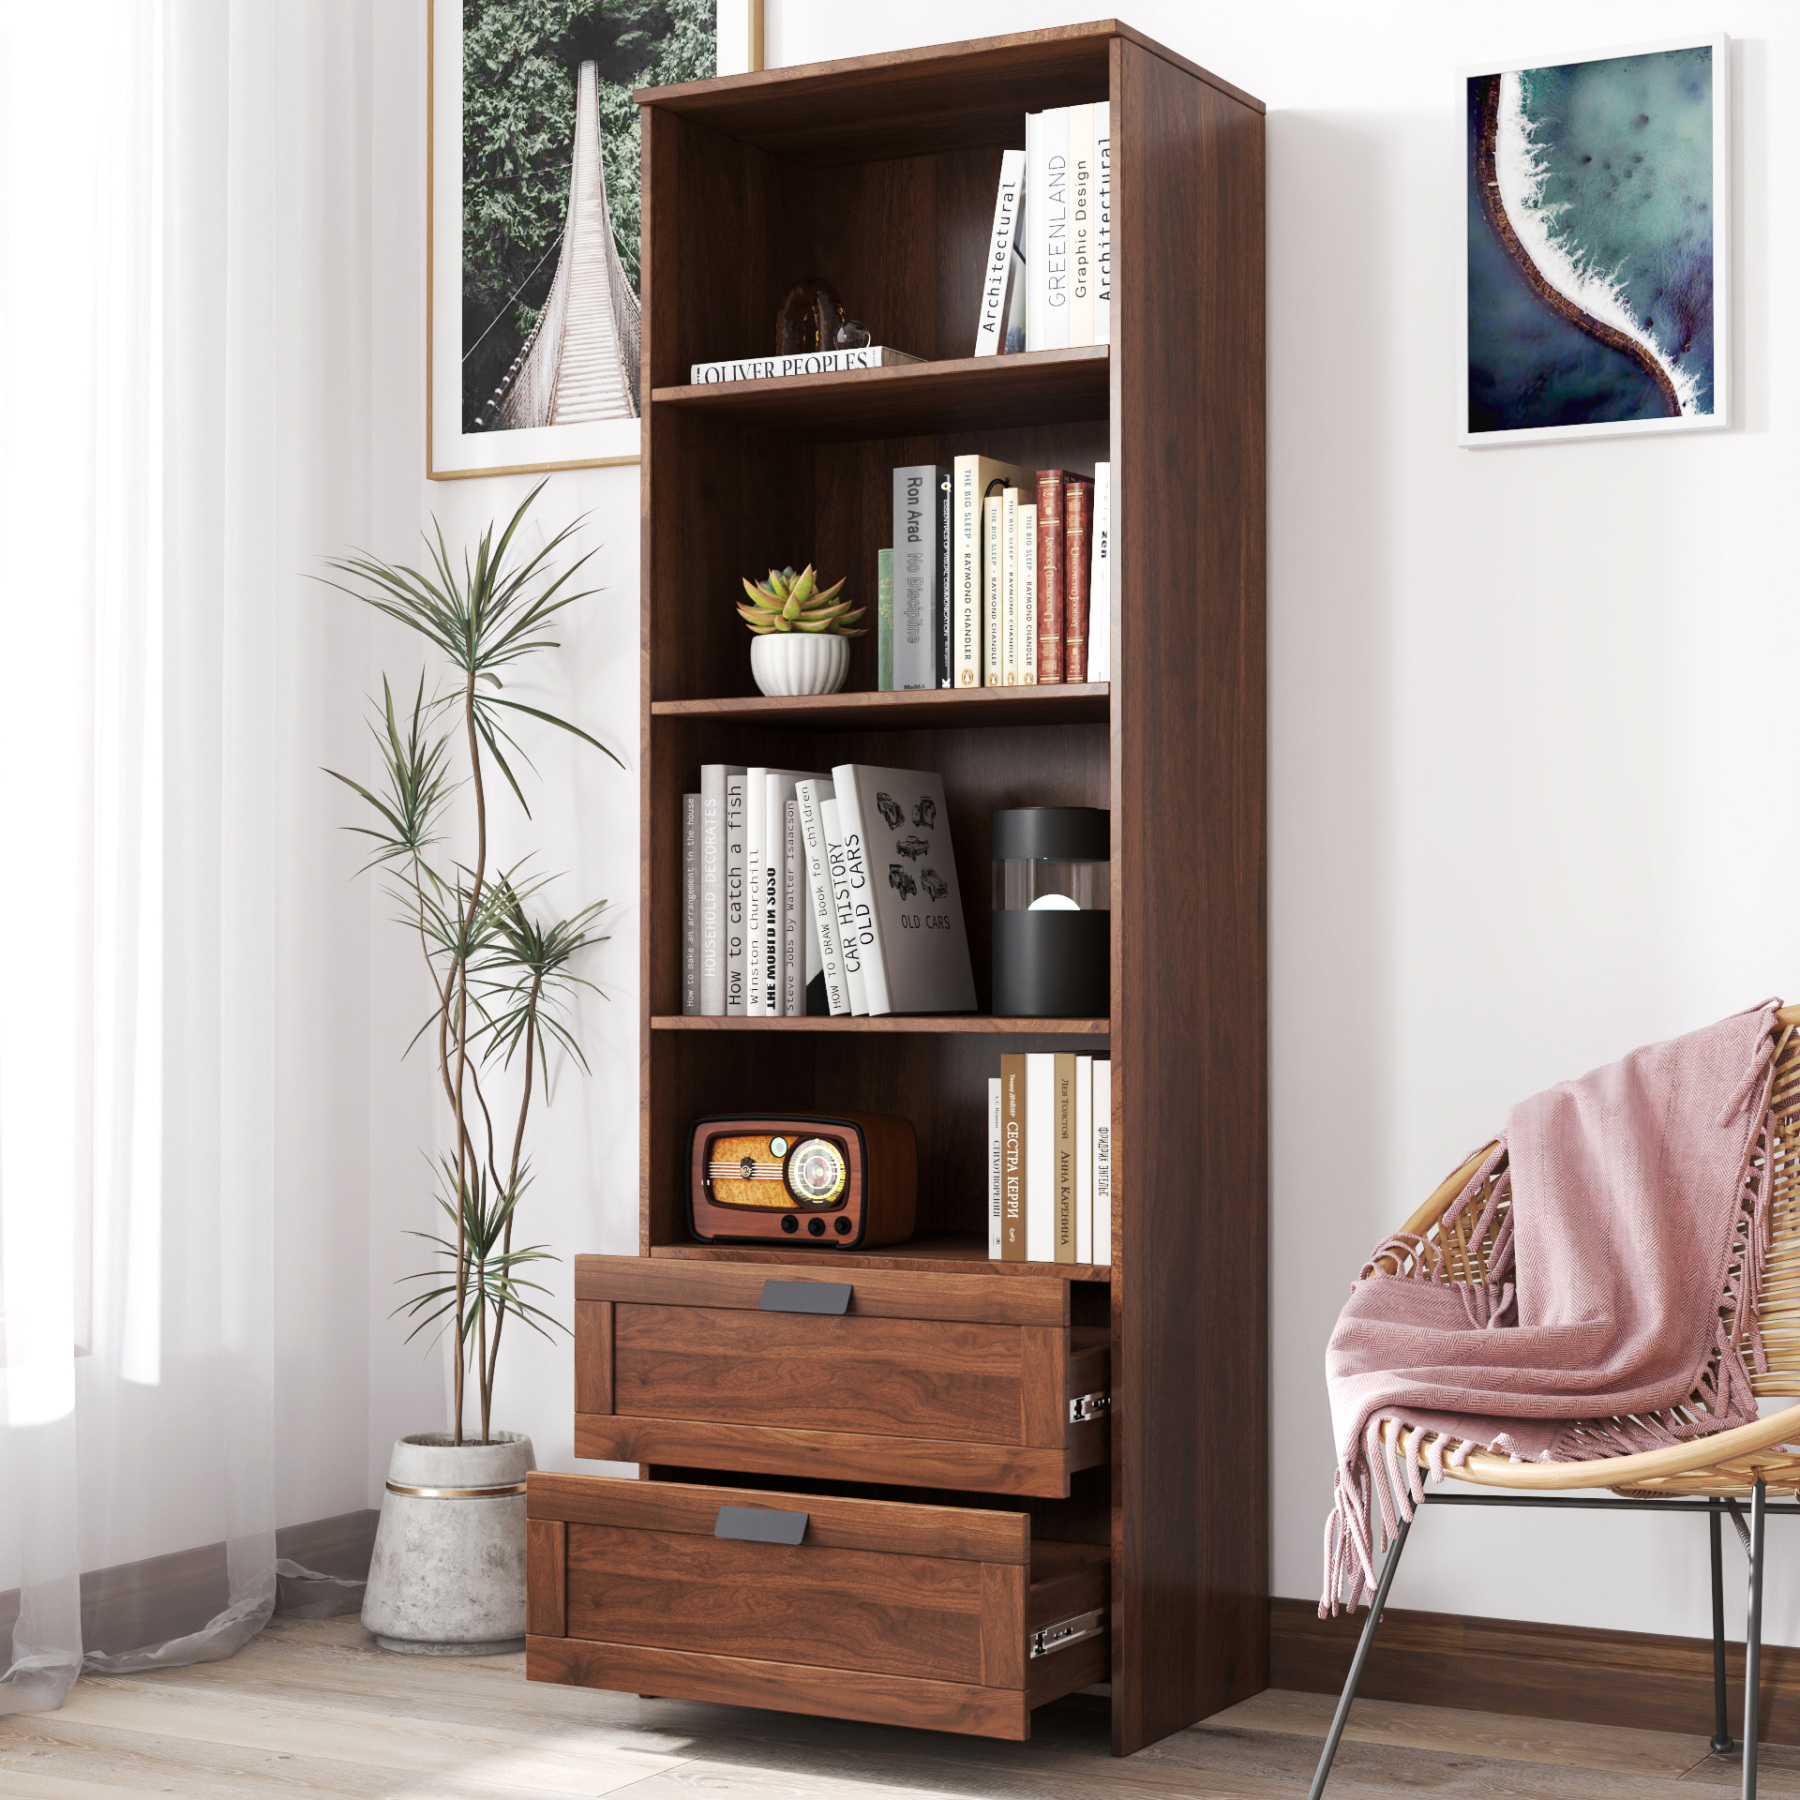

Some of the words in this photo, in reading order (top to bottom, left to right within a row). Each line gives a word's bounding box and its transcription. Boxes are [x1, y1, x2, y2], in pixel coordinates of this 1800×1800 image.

[1075, 160, 1089, 221] Design
[1049, 155, 1066, 307] GREENLAND
[1099, 138, 1110, 300] Architectural
[983, 182, 1015, 332] Architectural
[1075, 228, 1089, 298] Graphic
[705, 361, 775, 383] OLIVER
[782, 351, 868, 375] PEOPLES
[907, 477, 923, 506] Ron
[964, 469, 972, 487] THE
[964, 491, 972, 508] BIG
[907, 510, 923, 543] Arad
[964, 512, 972, 539] SLEEP
[907, 553, 923, 573] No
[964, 553, 972, 604] RAYMOND
[904, 576, 923, 644] Discipline
[964, 607, 972, 660] CHANDLER
[728, 785, 741, 830] fish
[801, 786, 817, 848] children
[705, 798, 716, 883] DECORATES
[731, 844, 741, 854] a
[786, 803, 794, 860] Isaacson
[687, 851, 694, 863] in
[812, 856, 821, 877] for
[844, 834, 865, 889] CARS
[687, 867, 696, 926] arrangement
[728, 867, 741, 923] catch
[750, 849, 758, 930] Churchill
[786, 868, 794, 911] Walter
[816, 886, 827, 917] Book
[828, 843, 853, 925] HISTORY
[688, 931, 694, 941] an
[705, 892, 716, 977] HOUSEHOLD
[786, 918, 796, 932] by
[821, 924, 833, 955] DRAW
[855, 904, 874, 945] OLD
[902, 915, 920, 929] OLD
[925, 915, 950, 930] CARS
[729, 937, 741, 958] to
[843, 936, 860, 973] CAR
[687, 974, 694, 984] to
[729, 971, 741, 1005] How
[750, 940, 758, 1004] Winston
[827, 962, 836, 978] TO
[830, 985, 841, 1009] HOW
[1007, 1121, 1019, 1172] СЕСТРА
[1098, 1127, 1109, 1161] ФРИДРИХ
[1007, 1176, 1019, 1219] КЕРРИ
